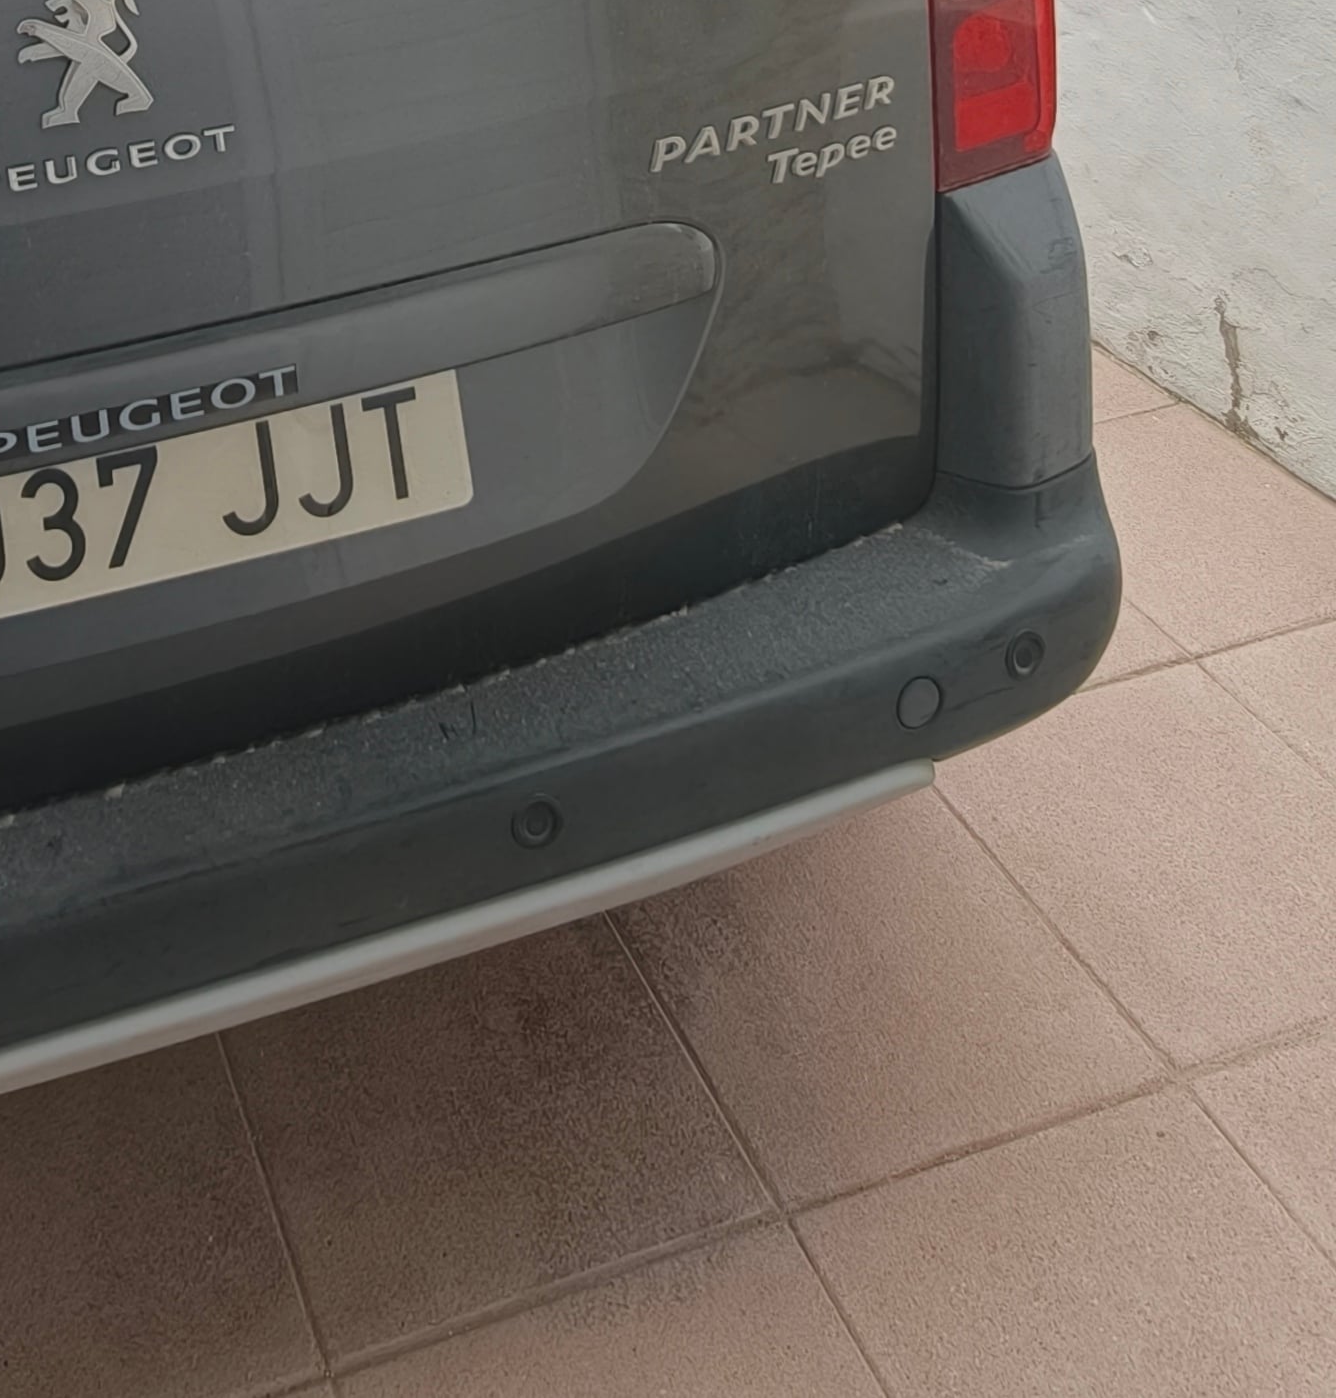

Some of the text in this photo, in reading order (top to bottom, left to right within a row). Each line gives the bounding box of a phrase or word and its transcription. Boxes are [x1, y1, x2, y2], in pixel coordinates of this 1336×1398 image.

[649, 75, 895, 172] PARTNER
[767, 125, 897, 184] Tepee
[222, 386, 417, 538] JJT
